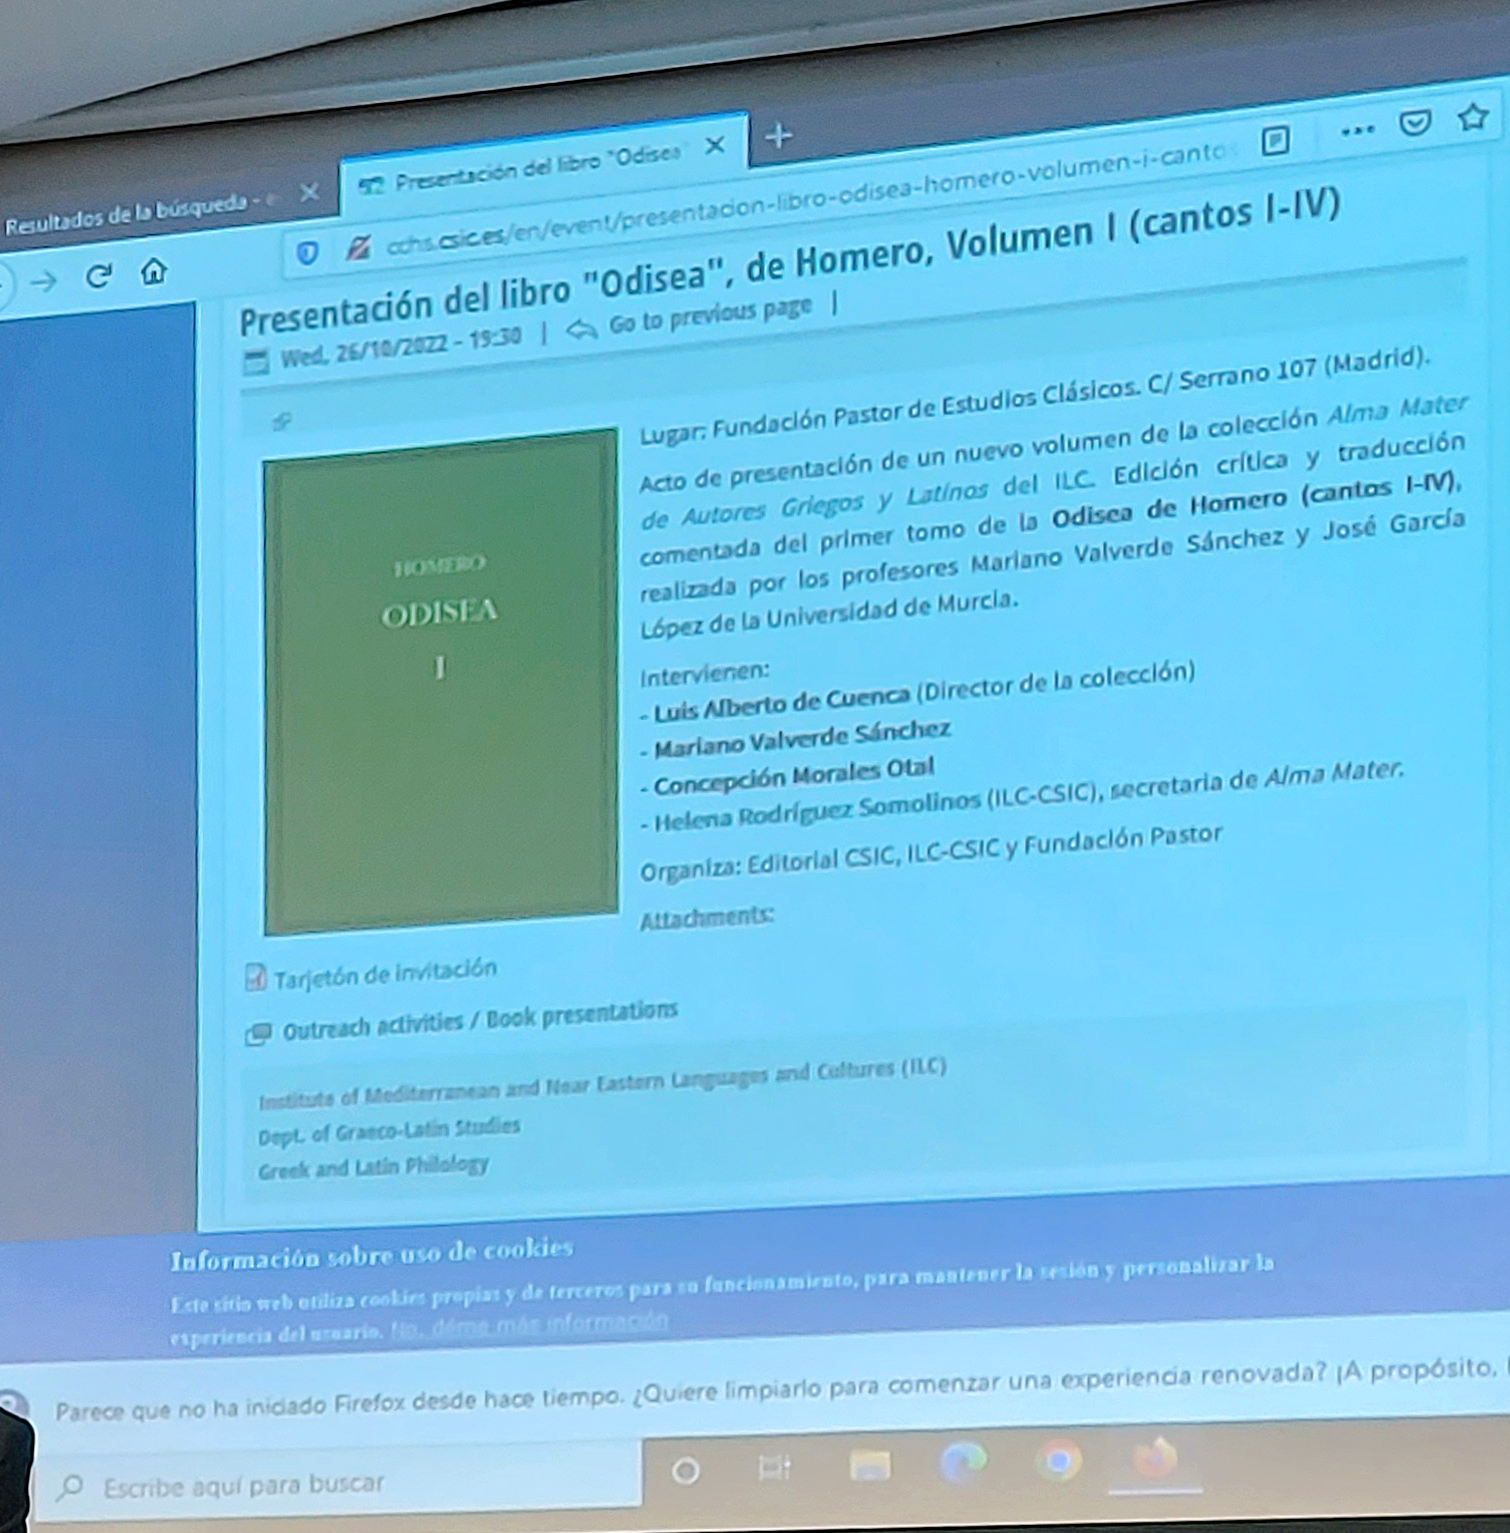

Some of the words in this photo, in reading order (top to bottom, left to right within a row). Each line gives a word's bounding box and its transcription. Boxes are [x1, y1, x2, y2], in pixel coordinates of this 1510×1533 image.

[4, 210, 105, 238] Resultados
[107, 205, 132, 226] de
[135, 202, 153, 222] la
[155, 193, 249, 221] búsqueda
[240, 288, 433, 338] Presentación
[444, 280, 490, 316] del
[501, 276, 571, 311] libro
[746, 249, 785, 283] de
[796, 241, 934, 278] Homero,
[946, 221, 1094, 261] Volumen
[1108, 211, 1115, 243] I
[1129, 200, 1253, 245] (cantos
[1266, 184, 1341, 225] I-IV)
[609, 314, 637, 336] Go
[642, 311, 664, 333] to
[670, 301, 758, 335] previous
[763, 296, 813, 325] page
[640, 425, 707, 450] Lugar:
[712, 407, 827, 439] Fundación
[834, 405, 904, 428] Pastor
[907, 397, 936, 420] de
[942, 388, 1038, 417] Estudios
[1042, 378, 1142, 406] Clásicos.
[1178, 365, 1271, 392] Serrano
[1276, 356, 1318, 382] 107
[1324, 343, 1431, 380] (Madrid).
[380, 597, 500, 630] ODISEA
[641, 615, 705, 642] López
[766, 597, 898, 630] Universidad
[937, 587, 1019, 614] Murcia.
[433, 654, 448, 681] I
[640, 662, 770, 689] Intervienen:
[654, 700, 700, 725] Luis
[825, 687, 912, 711] Cuenca
[916, 678, 1015, 706] (Director
[1079, 657, 1195, 690] colección)
[654, 735, 746, 761] Mariano
[748, 724, 849, 752] Valverde
[854, 718, 952, 745] Sánchez
[653, 766, 787, 797] Concepción
[792, 759, 882, 786] Morales
[886, 754, 935, 779] Otal
[640, 856, 742, 887] Organiza:
[747, 846, 839, 875] Editorial
[844, 844, 902, 869] CSIC,
[907, 836, 1001, 865] ILC-CSIC
[1024, 825, 1144, 856] Fundación
[1150, 825, 1224, 848] Pastor
[273, 964, 359, 995] Tarjetón
[395, 955, 498, 983] invitación
[170, 1246, 320, 1273] Información
[328, 1243, 394, 1269] sobre
[400, 1247, 442, 1265] uso
[448, 1238, 477, 1262] de
[483, 1235, 574, 1261] cookies
[103, 1475, 185, 1501] Escribe
[192, 1474, 244, 1501] aquí
[249, 1477, 301, 1499] para
[309, 1471, 386, 1495] buscar
